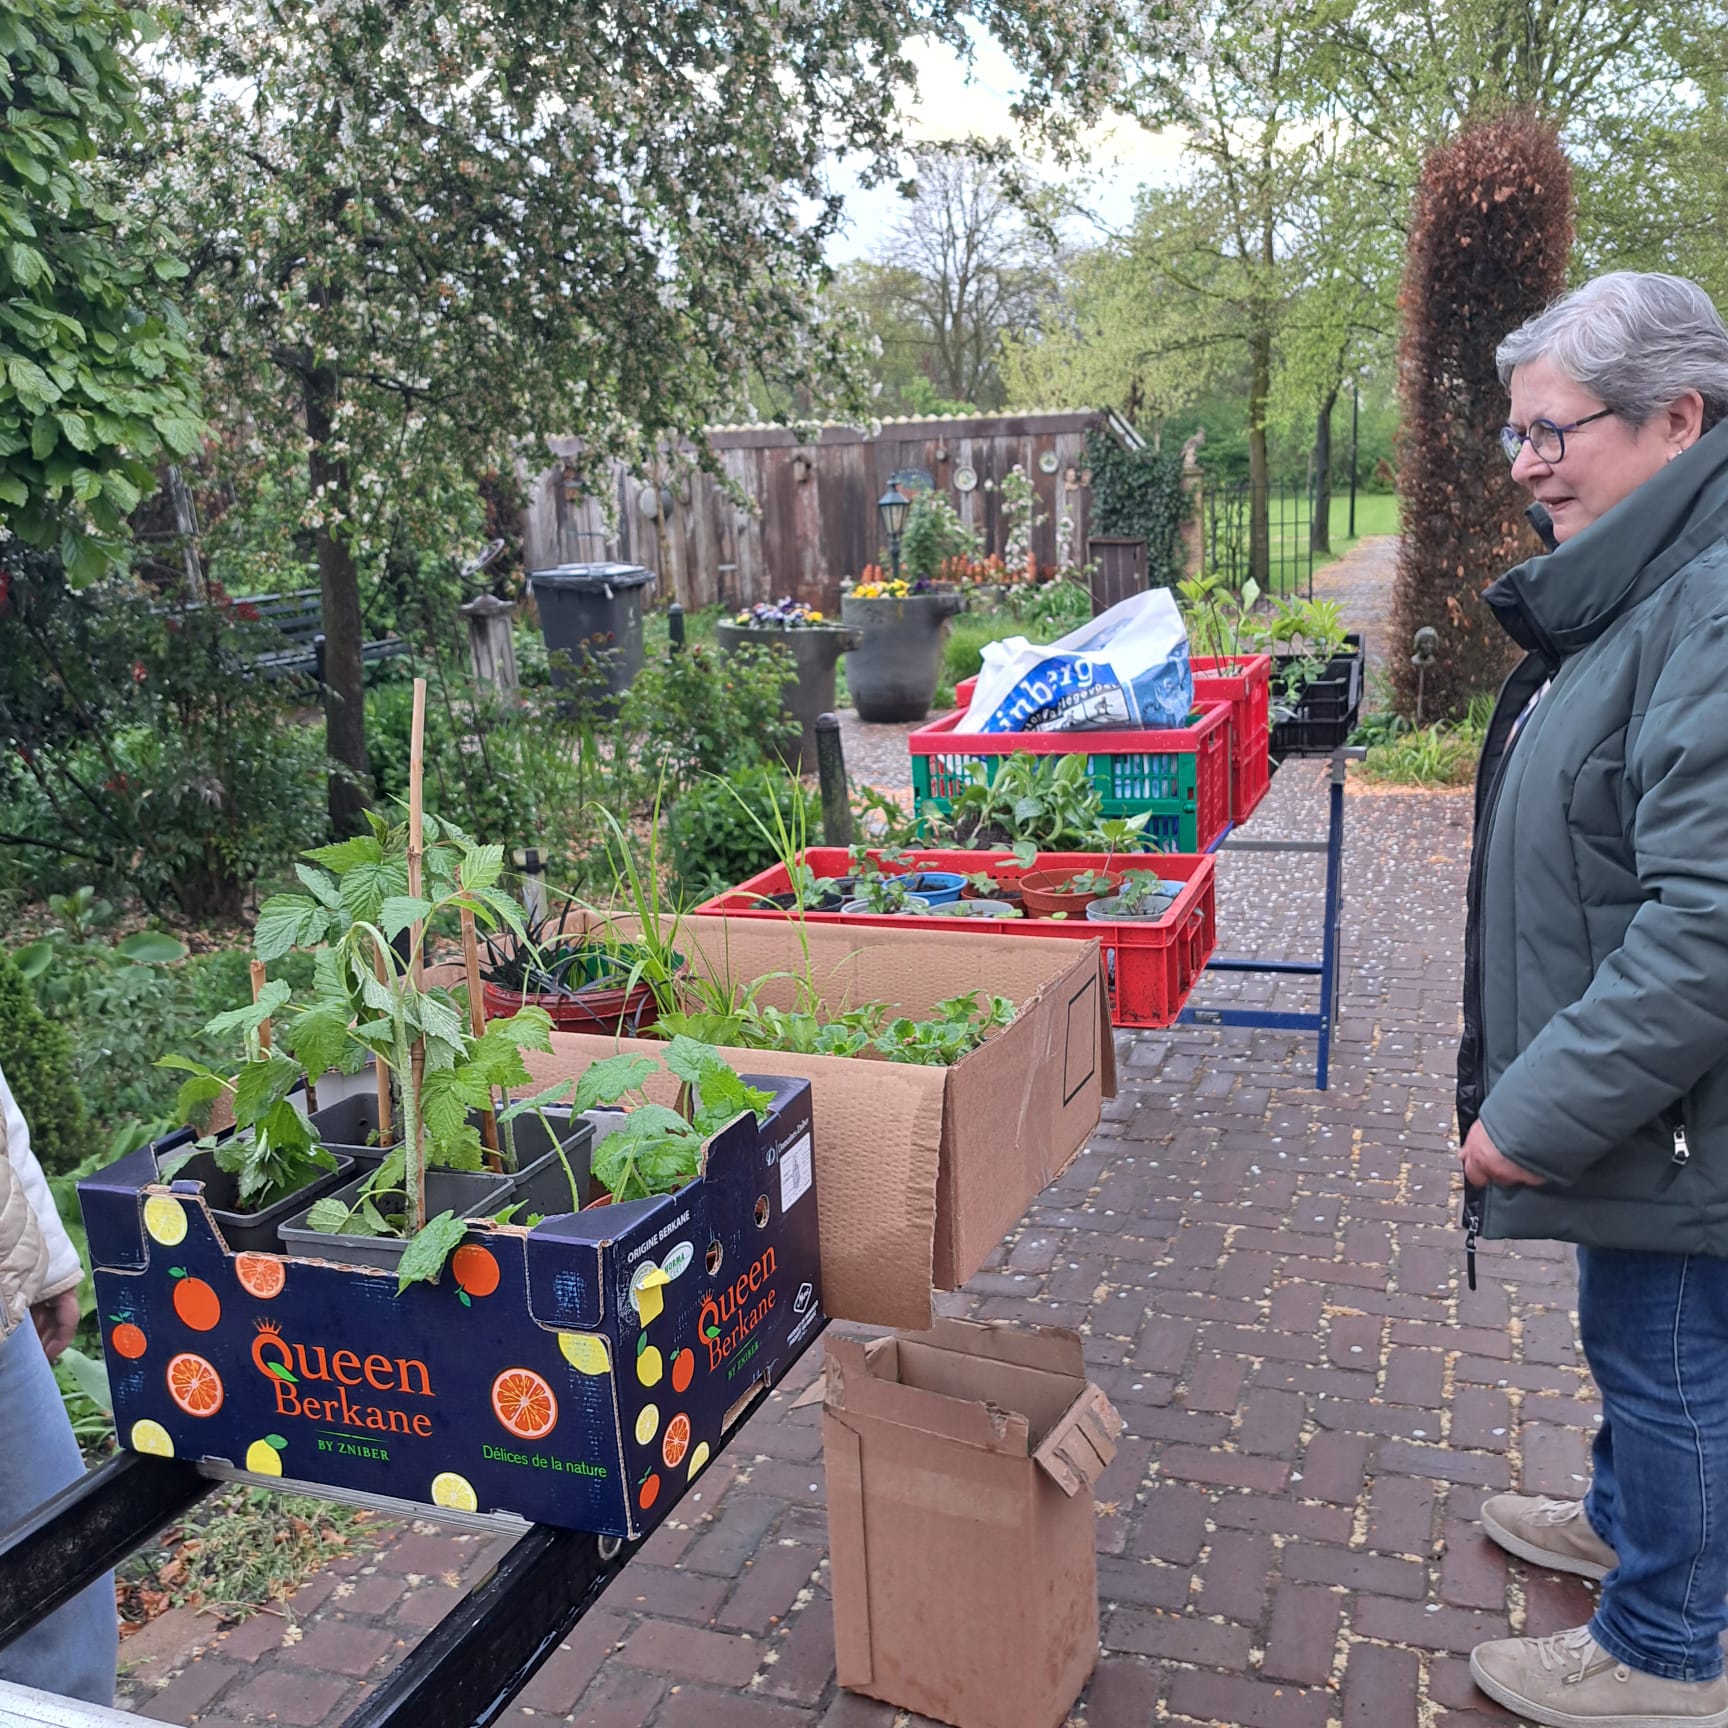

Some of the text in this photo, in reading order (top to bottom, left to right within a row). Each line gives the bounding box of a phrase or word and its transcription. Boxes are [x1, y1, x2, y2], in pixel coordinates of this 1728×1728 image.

[627, 1210, 691, 1263] ORIGINE BERKANE
[664, 1252, 686, 1273] NORMA
[697, 1246, 778, 1345] Queen
[707, 1289, 776, 1372] Berkane
[251, 1332, 436, 1397] Queen
[271, 1379, 433, 1437] Berkane
[317, 1439, 391, 1461] BY ZNIBER
[482, 1444, 608, 1478] Délices de la nature
